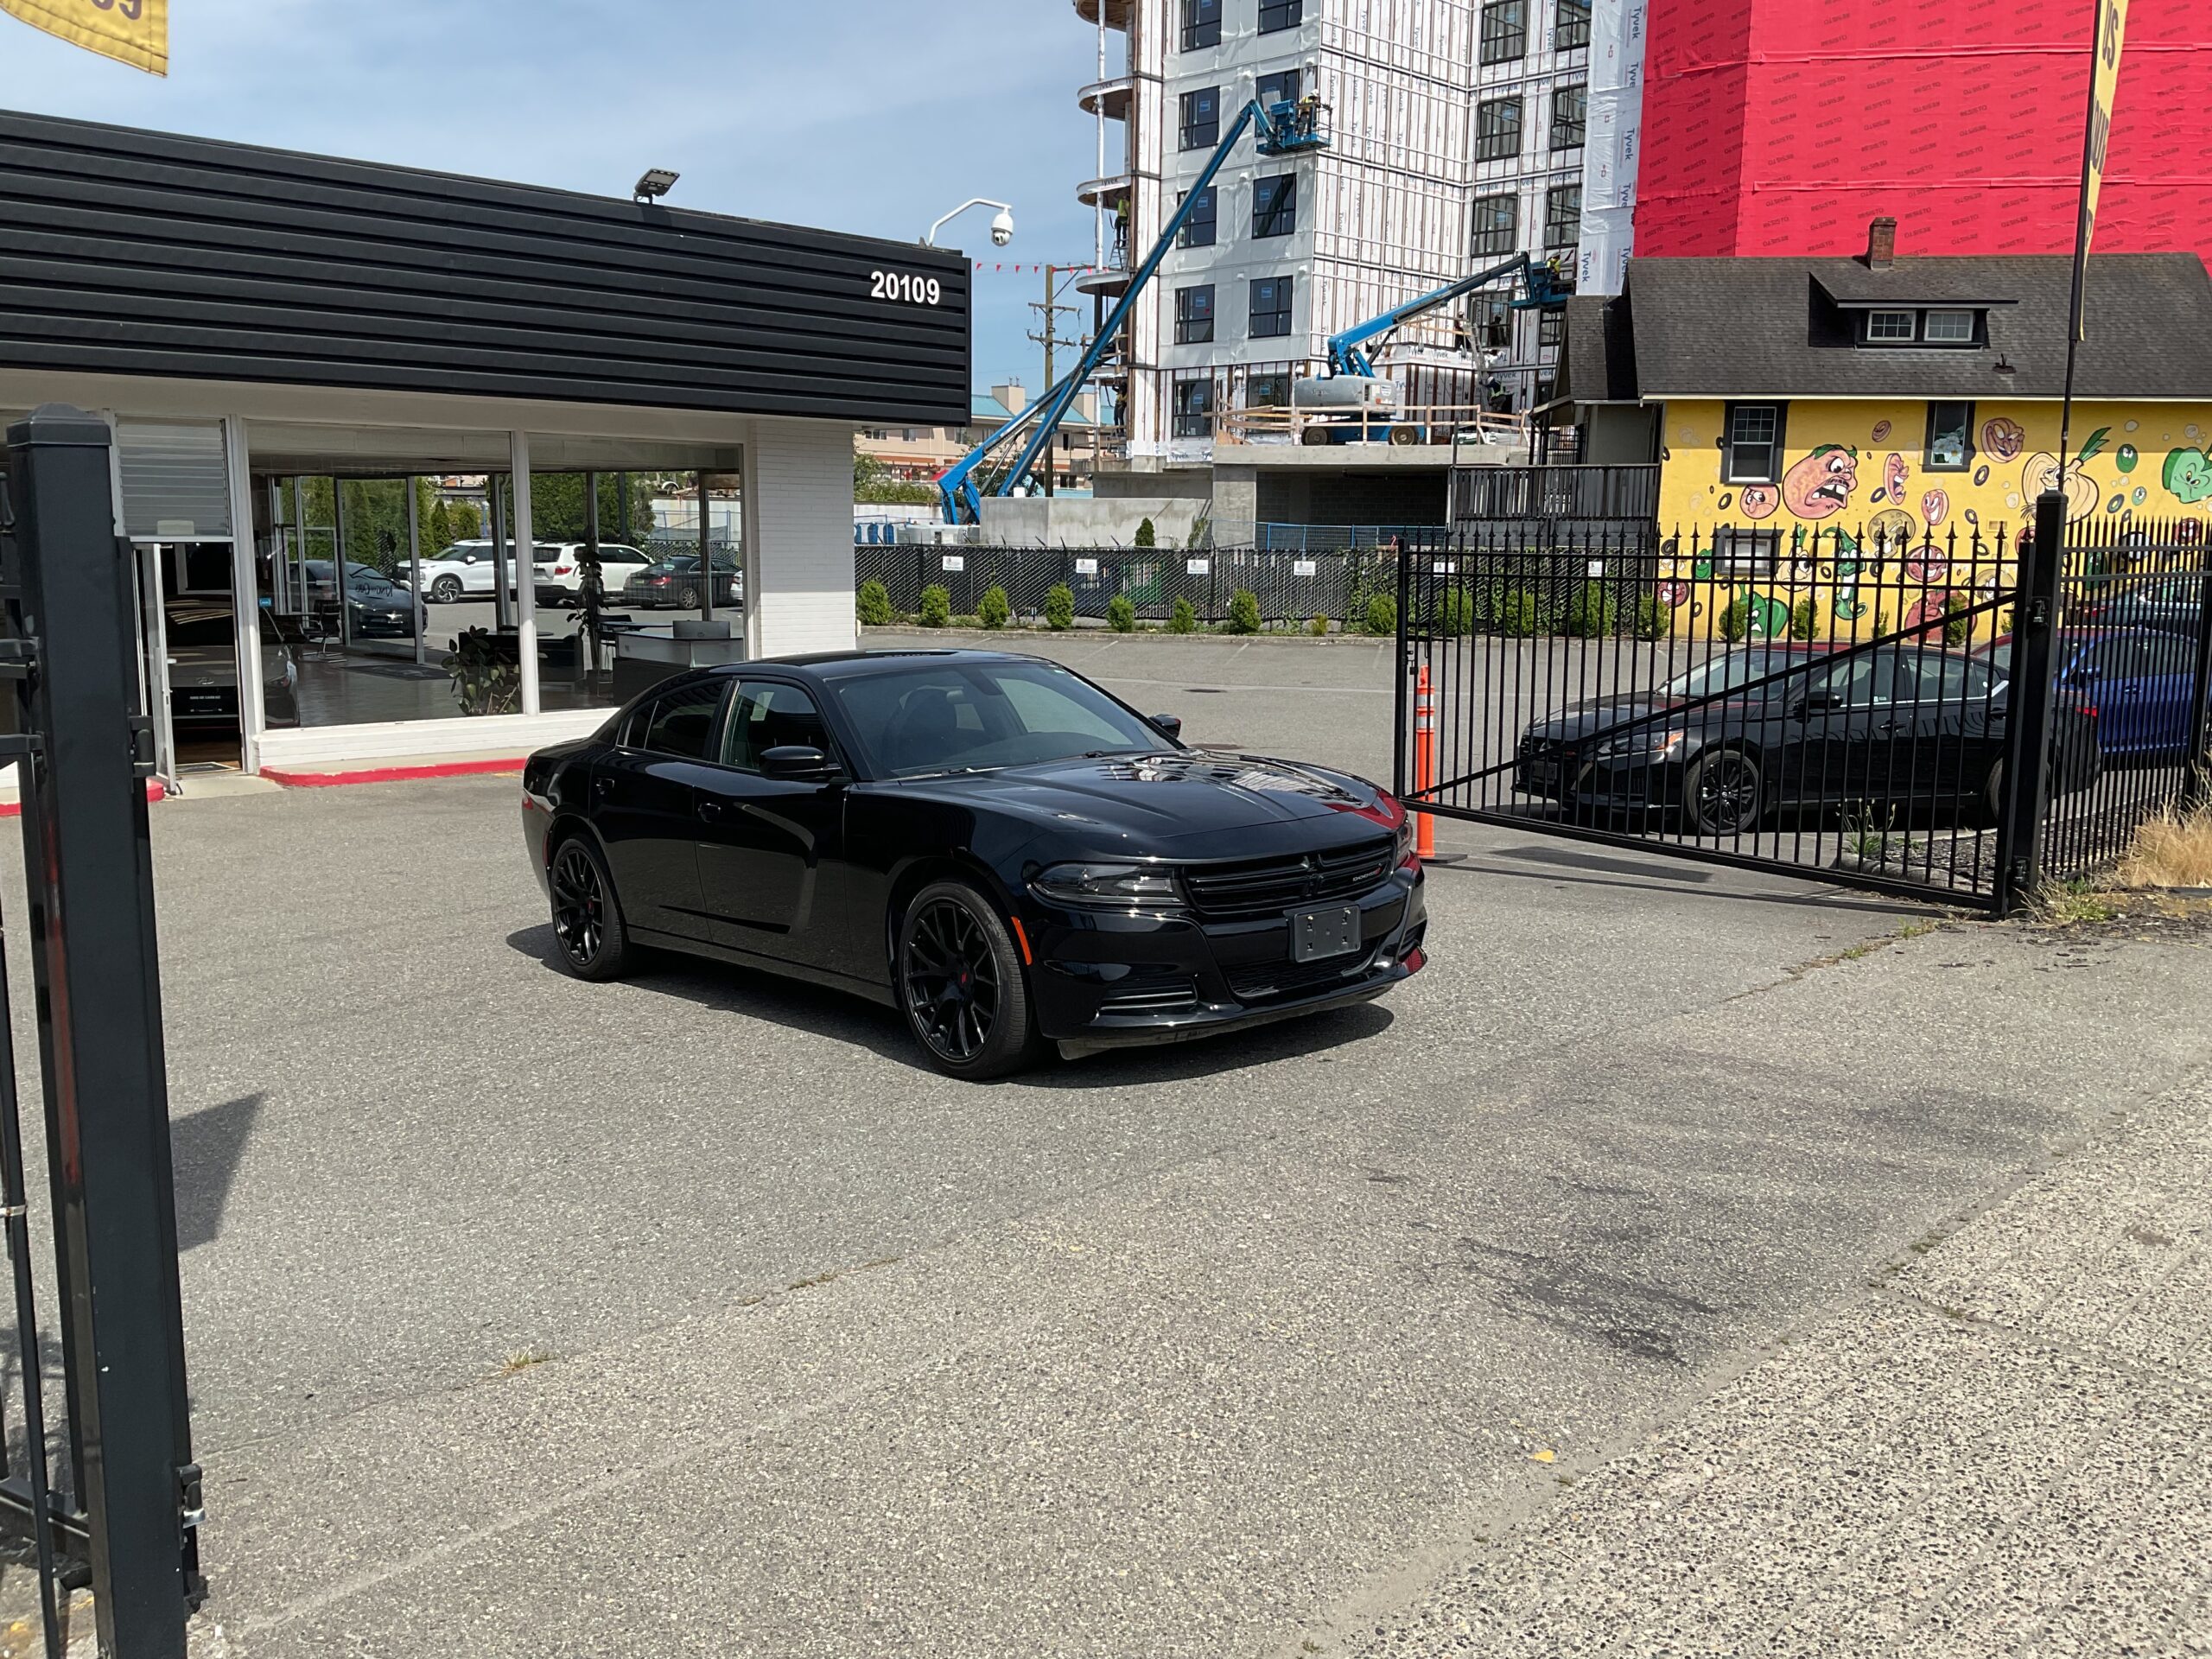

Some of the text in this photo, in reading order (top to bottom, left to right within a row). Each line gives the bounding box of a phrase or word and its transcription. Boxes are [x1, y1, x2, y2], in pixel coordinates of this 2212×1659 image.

[1630, 6, 1642, 40] Tyvek
[1629, 61, 1639, 87] Tyve
[1624, 127, 1635, 161] Tyvek
[1621, 182, 1631, 207] Tyve
[1581, 251, 1592, 283] Tyvek
[870, 270, 940, 305] 20109
